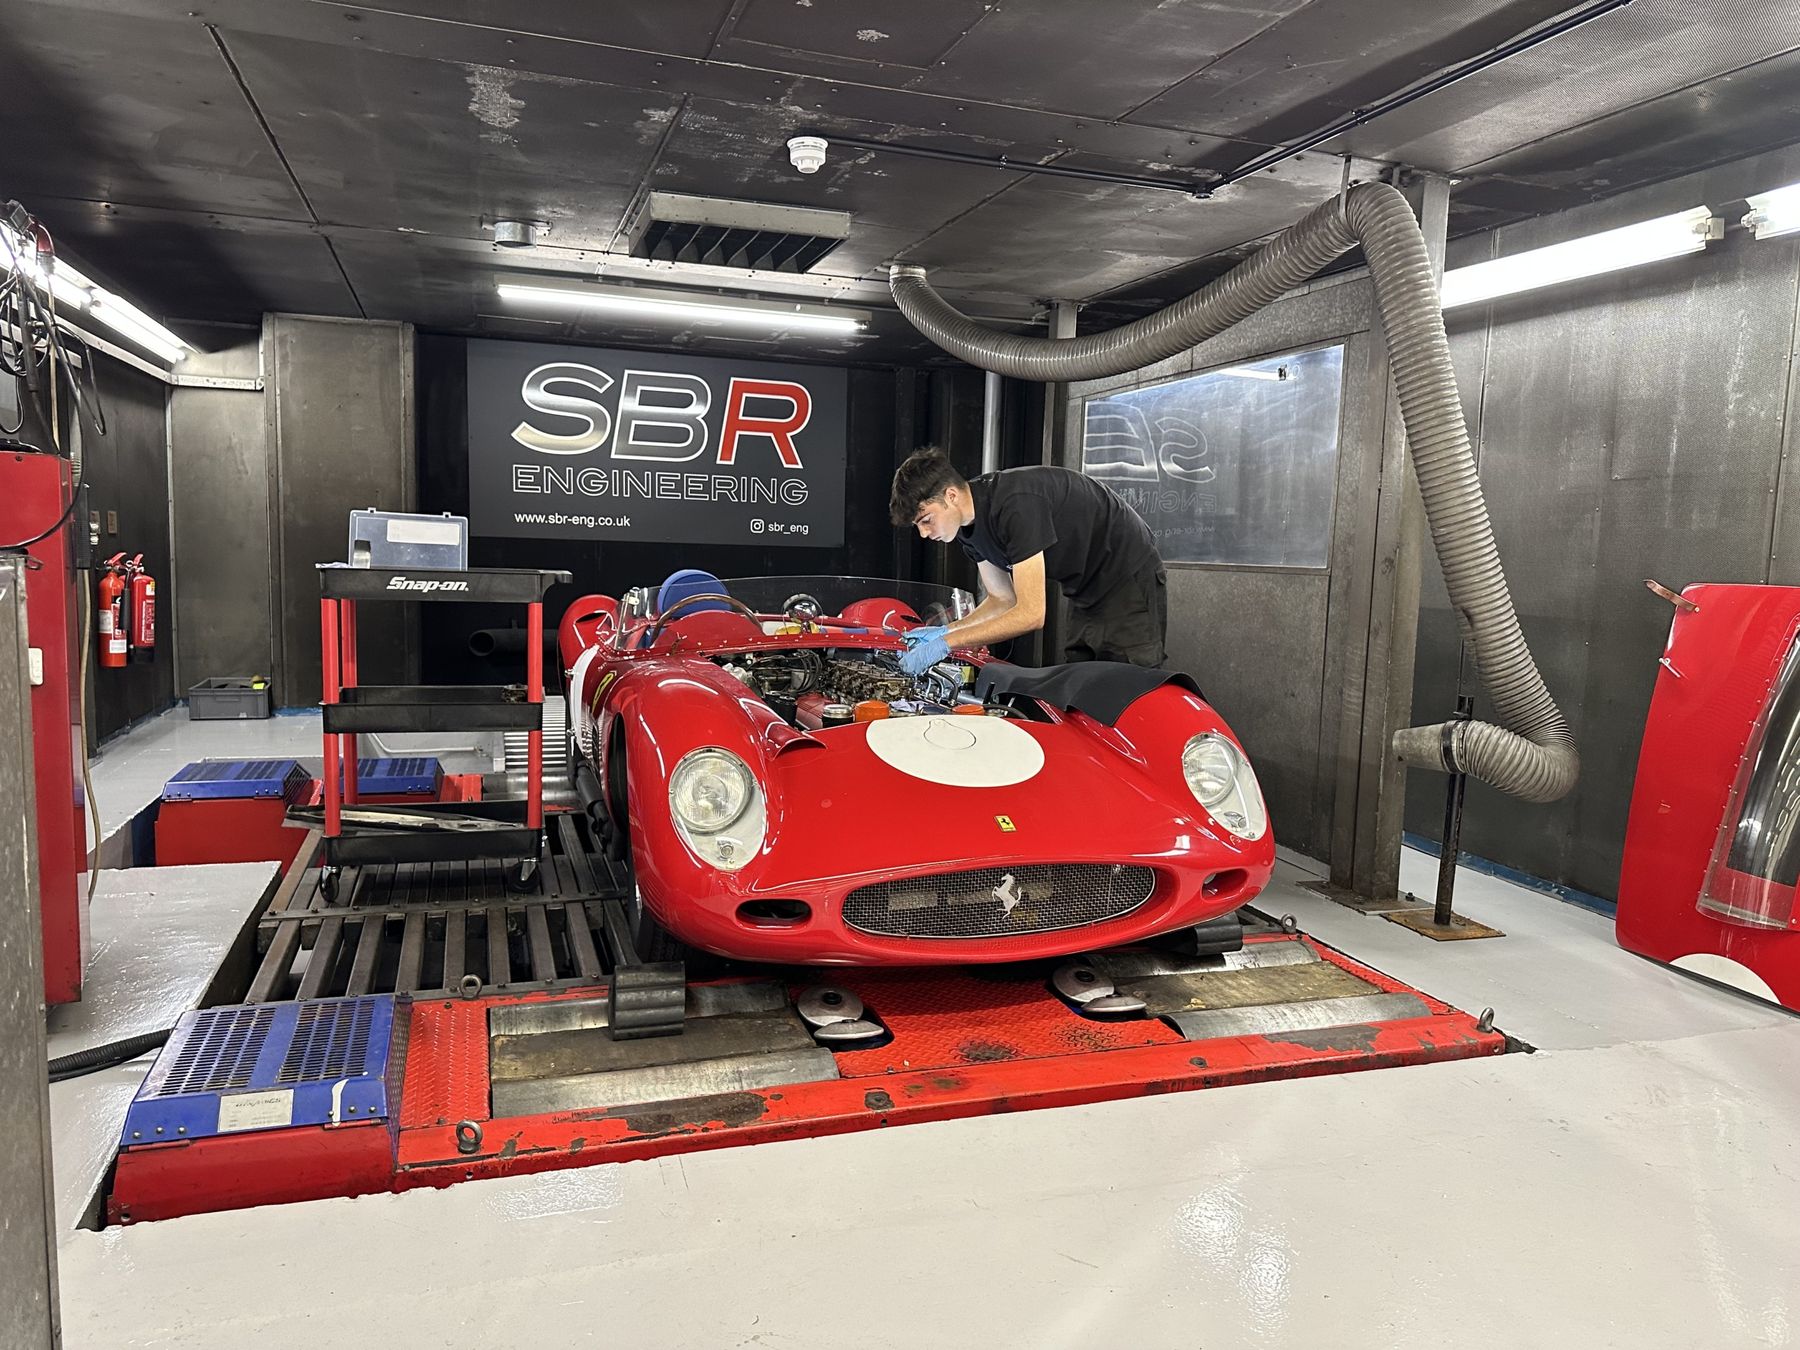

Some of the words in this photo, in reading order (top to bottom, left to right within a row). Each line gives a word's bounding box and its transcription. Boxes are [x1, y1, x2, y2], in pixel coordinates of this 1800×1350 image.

[511, 362, 813, 469] SBR
[512, 464, 809, 506] ENGINEERING
[514, 513, 631, 529] www.sbr-eng.co.uk
[768, 521, 809, 535] sbr_eng
